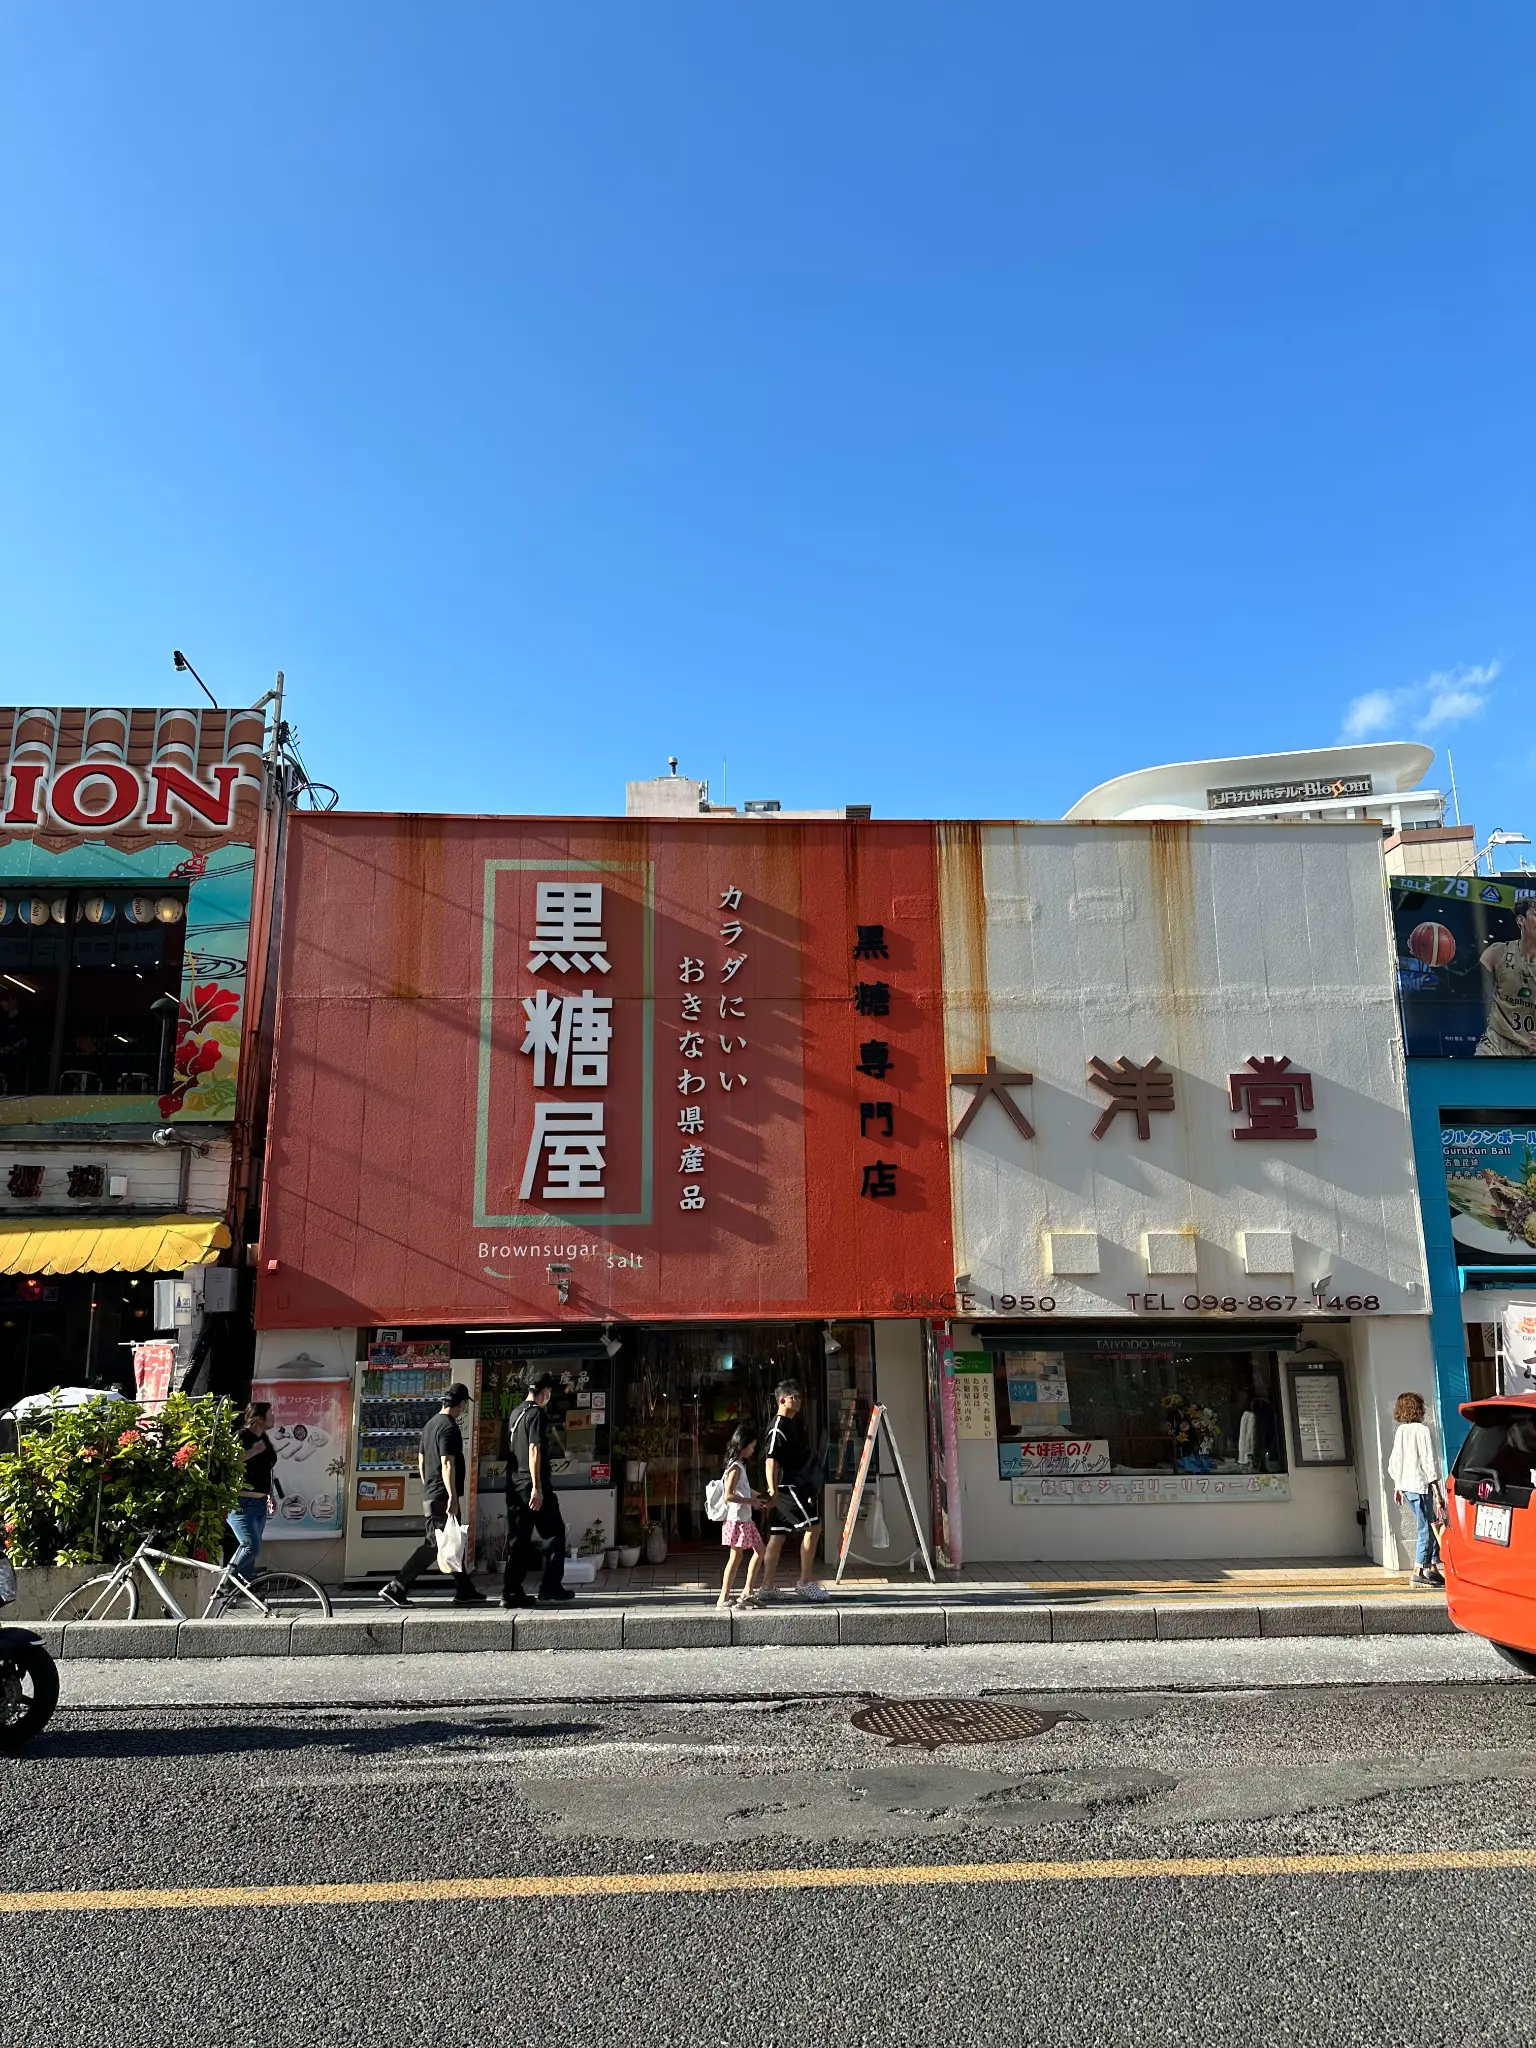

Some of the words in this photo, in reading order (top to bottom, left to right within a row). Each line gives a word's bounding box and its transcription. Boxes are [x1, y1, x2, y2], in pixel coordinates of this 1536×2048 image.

[4, 762, 240, 828] ION
[1443, 876, 1469, 897] 79
[718, 884, 748, 1092] カラダにいい
[1511, 1011, 1535, 1033] 30
[518, 881, 613, 1200] 黒糖屋
[853, 924, 898, 1199] 黒糖専門店
[676, 956, 707, 1212] おきなわ県産品
[949, 1054, 1318, 1141] 大洋堂
[1440, 1128, 1536, 1145] グルクンボール
[1443, 1146, 1487, 1156] Gurukun
[1491, 1146, 1511, 1156] Ball
[478, 1242, 599, 1260] Brownsugar
[607, 1252, 644, 1269] salt
[990, 1295, 1056, 1312] 1950
[1126, 1293, 1175, 1312] TEL
[1183, 1294, 1380, 1313] 098-867-1468
[1096, 1340, 1149, 1349] TAIYODO
[1152, 1339, 1182, 1349] Jewelry
